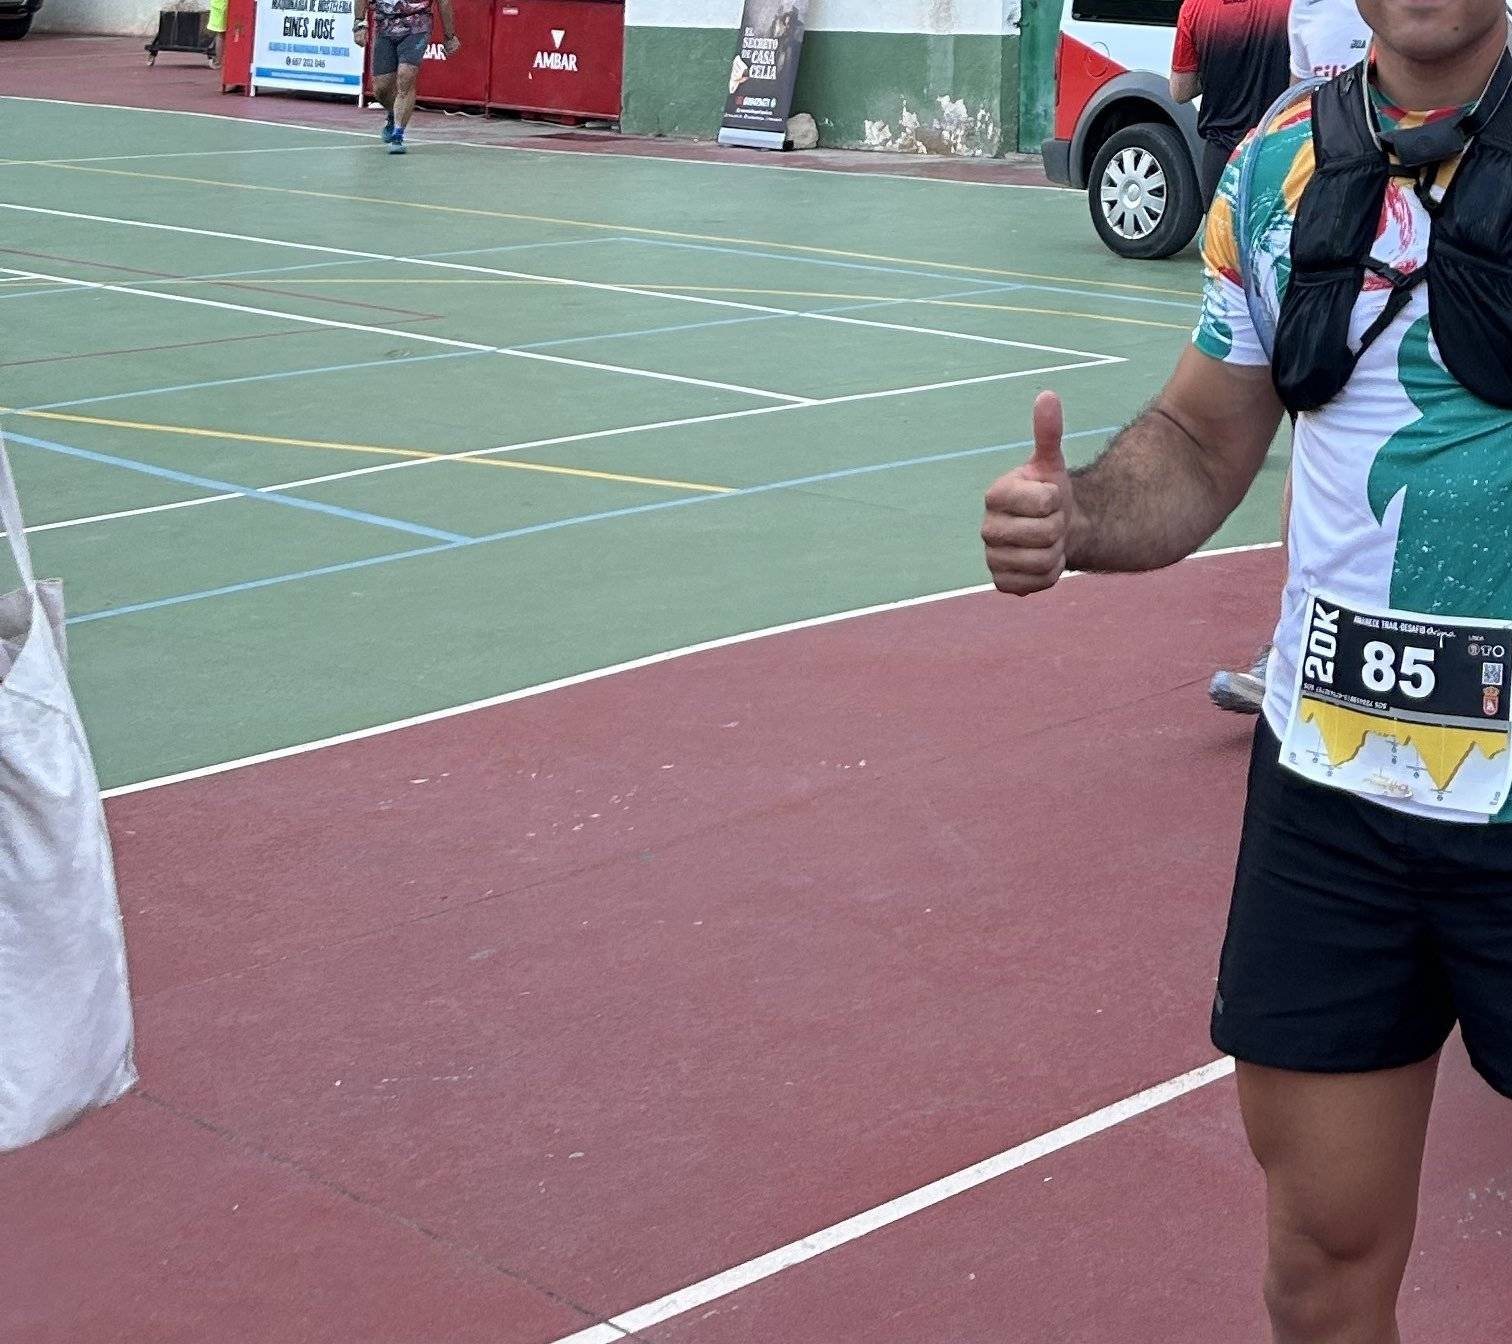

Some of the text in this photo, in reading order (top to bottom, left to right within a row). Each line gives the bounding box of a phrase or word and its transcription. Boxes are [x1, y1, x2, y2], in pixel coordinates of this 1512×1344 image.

[532, 51, 578, 72] AMBAR
[751, 50, 775, 65] CASA
[749, 64, 777, 80] CELIA
[1304, 602, 1340, 685] 20K
[1361, 640, 1436, 699] 85
